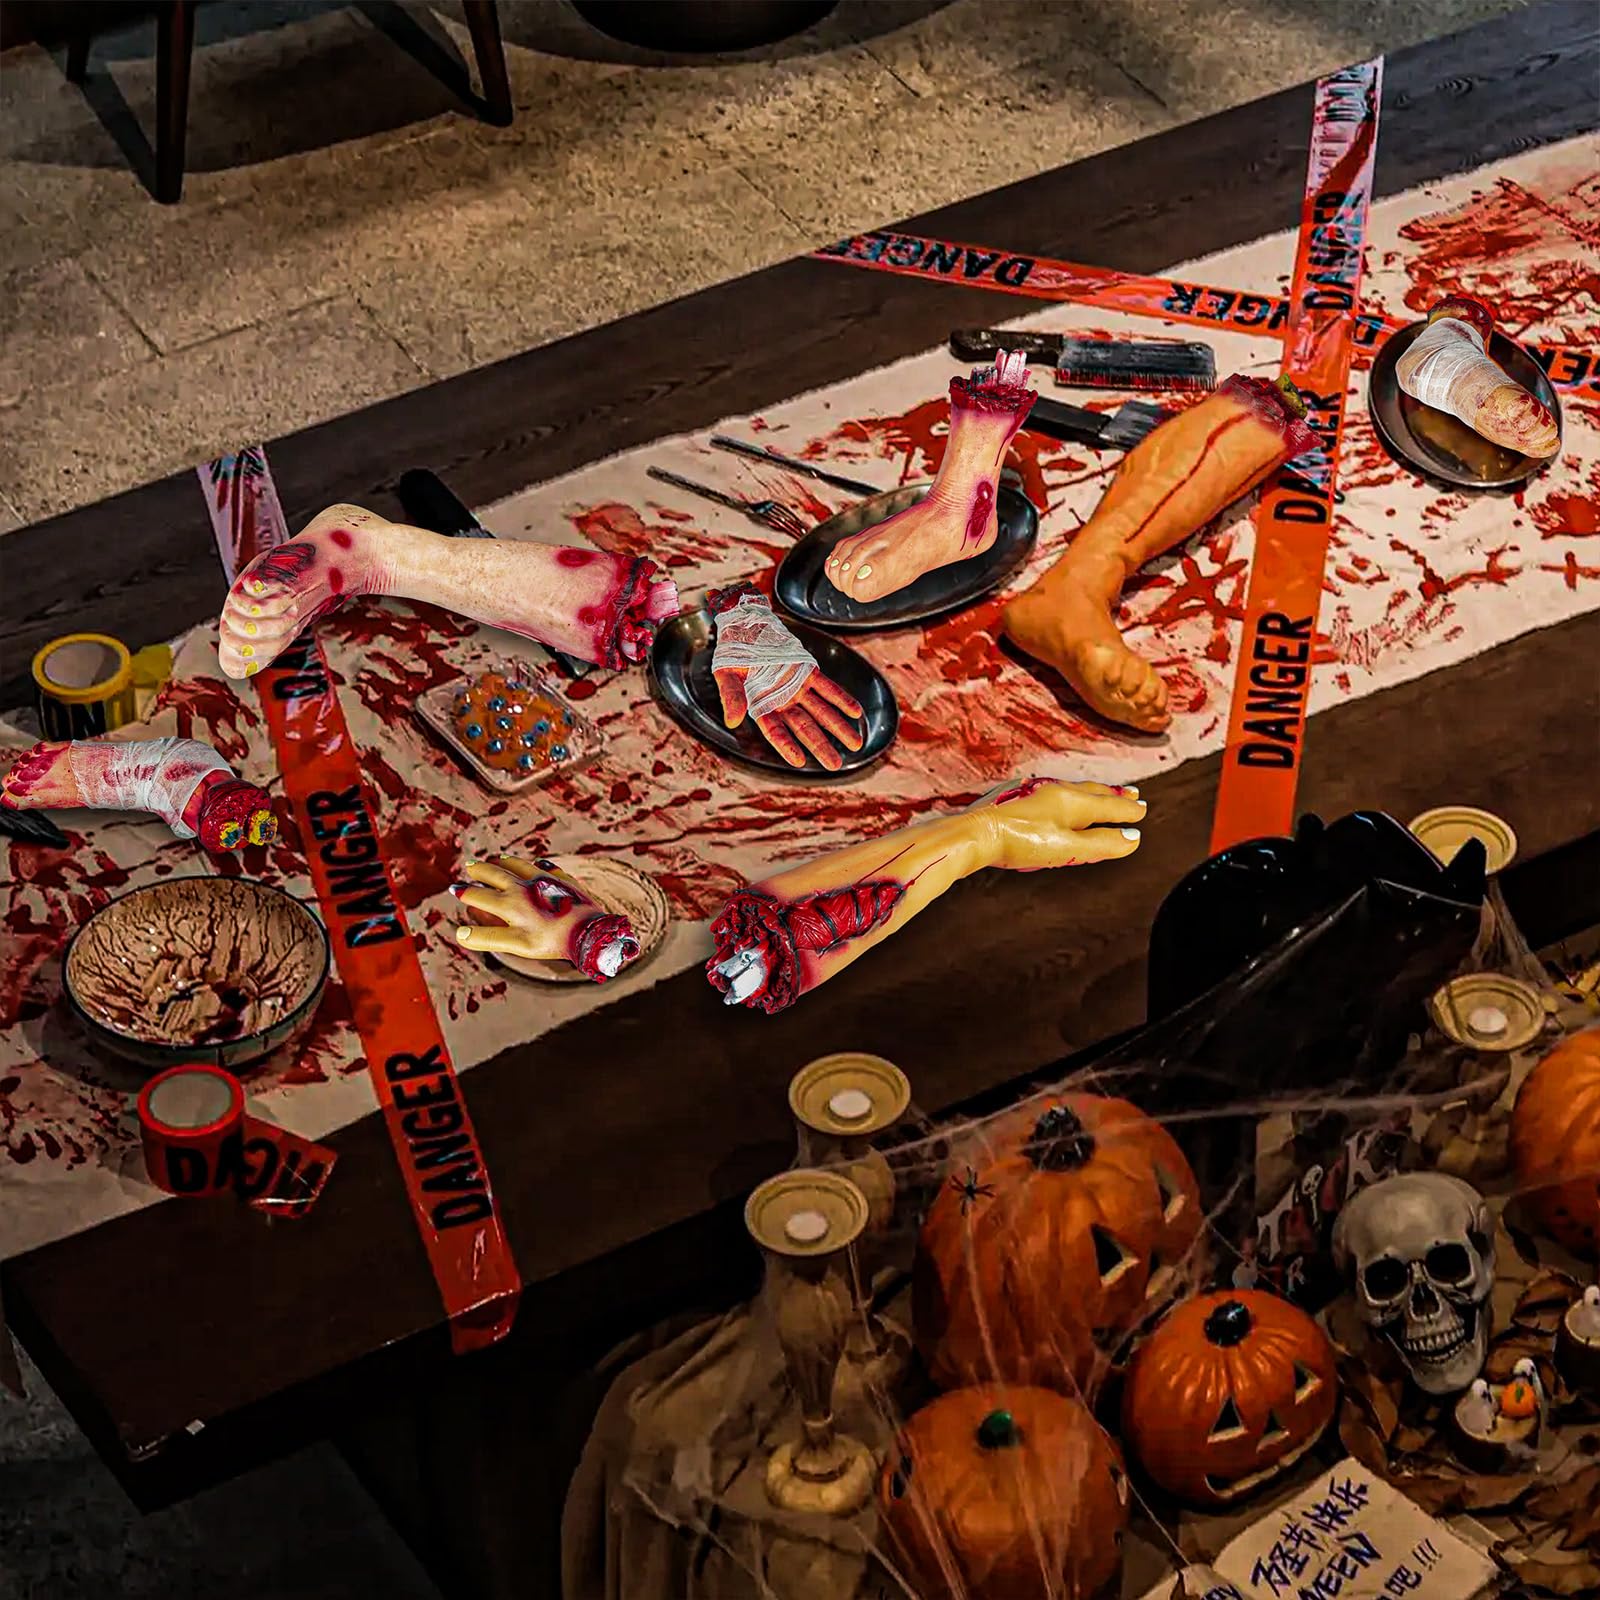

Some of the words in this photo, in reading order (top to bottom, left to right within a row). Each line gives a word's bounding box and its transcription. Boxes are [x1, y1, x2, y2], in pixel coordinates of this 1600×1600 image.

[1238, 612, 1314, 768] DANGER
[306, 784, 405, 948] DANGER
[385, 1044, 493, 1231] DANGER
